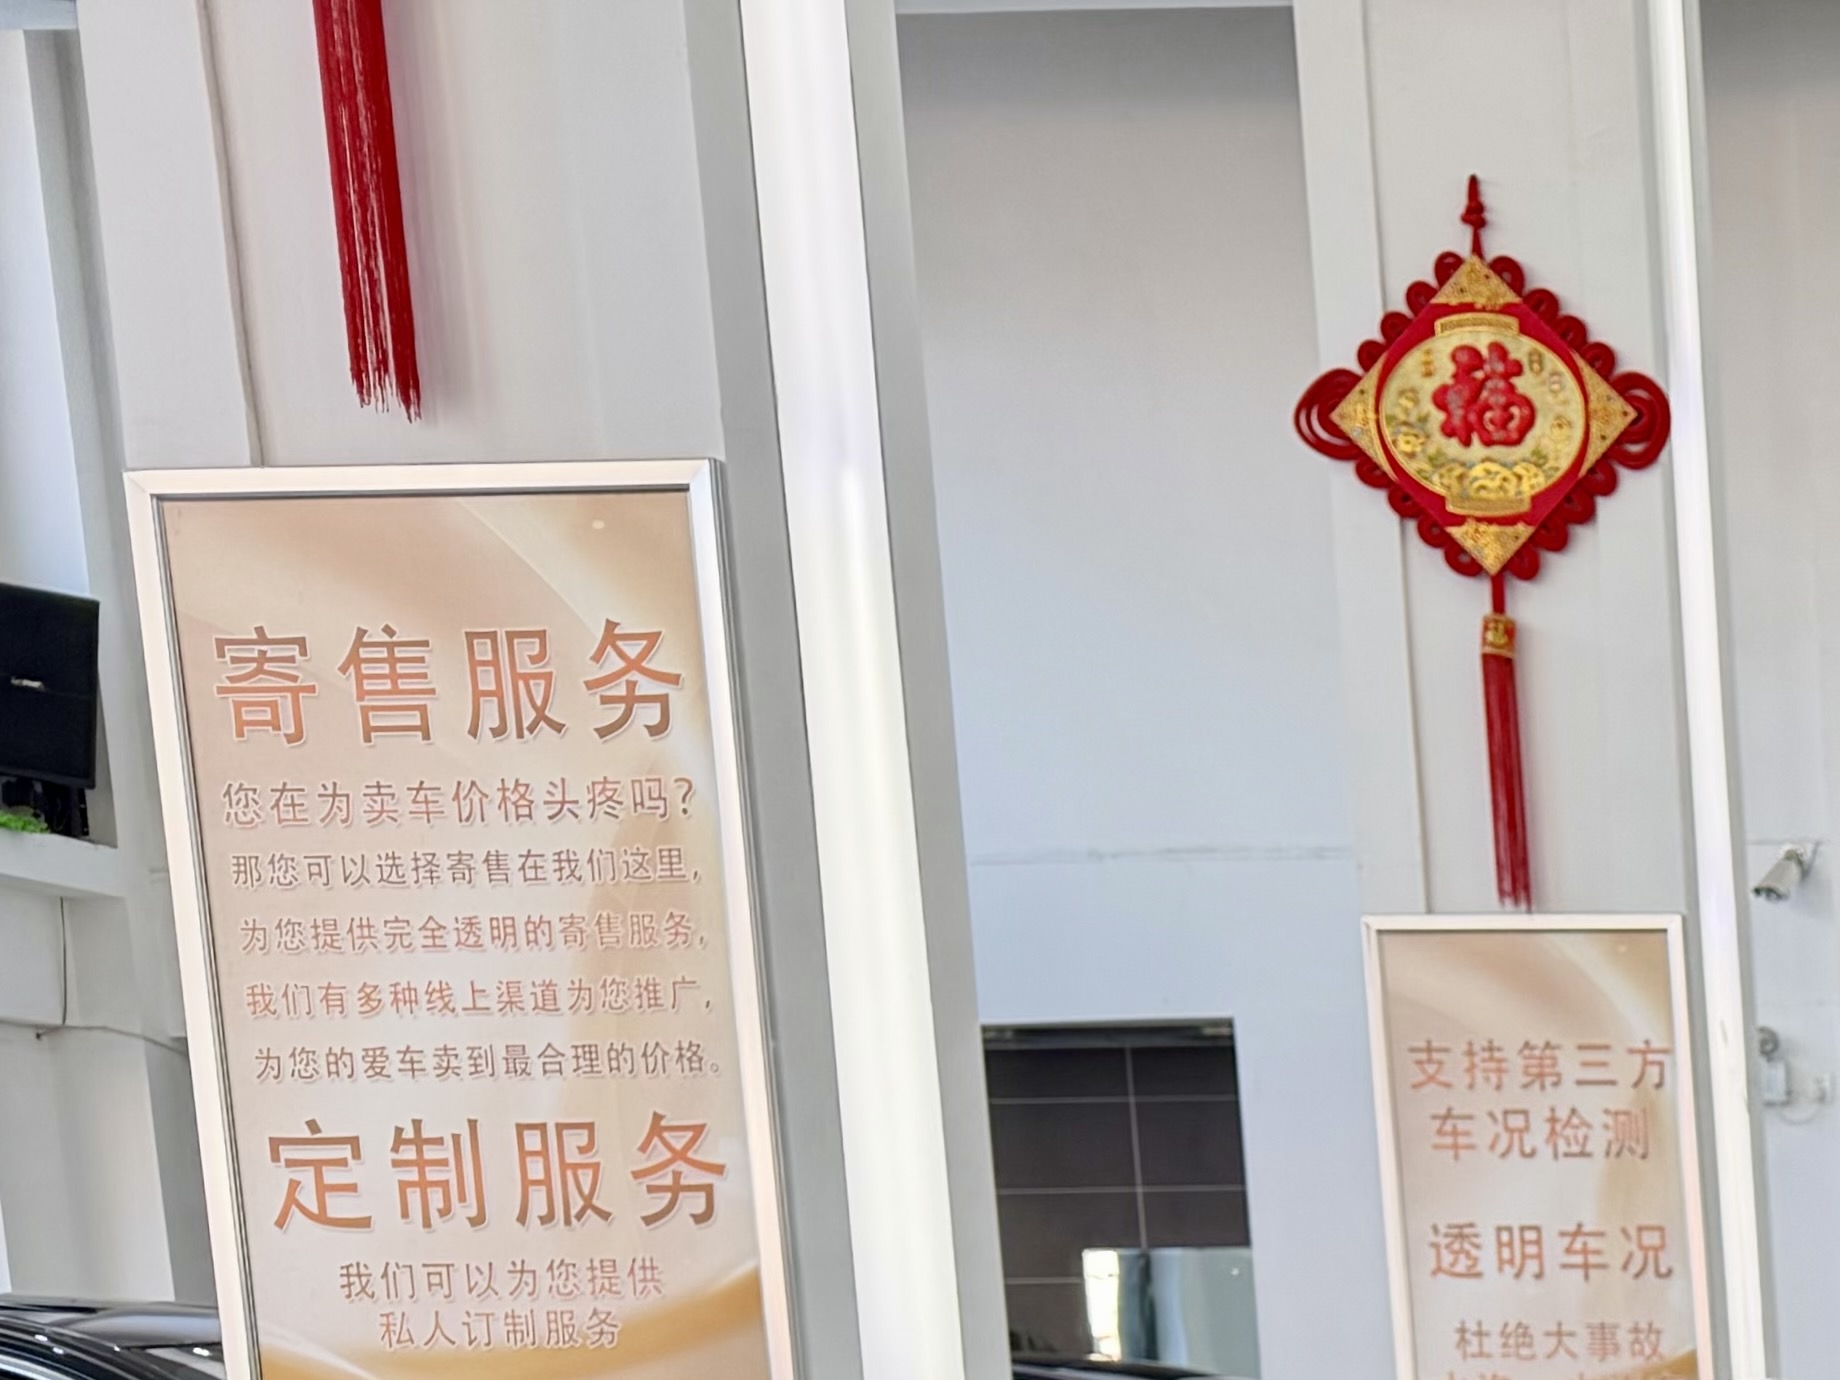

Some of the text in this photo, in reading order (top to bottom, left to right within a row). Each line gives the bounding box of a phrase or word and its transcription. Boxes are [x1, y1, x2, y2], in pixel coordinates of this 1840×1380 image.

[1432, 342, 1535, 447] 福
[213, 617, 683, 745] 寄售服务
[222, 776, 695, 826] 您在为卖车价格头疼吗？
[1408, 1040, 1672, 1091] 支持第三方
[1430, 1107, 1650, 1162] 车况检测
[268, 1111, 727, 1231] 定制服务
[1427, 1222, 1674, 1281] 透明车况
[339, 1258, 665, 1301] 我们可以为您提供
[378, 1310, 622, 1349] 私人订制服务
[1455, 1320, 1666, 1361] 杜绝大事故
